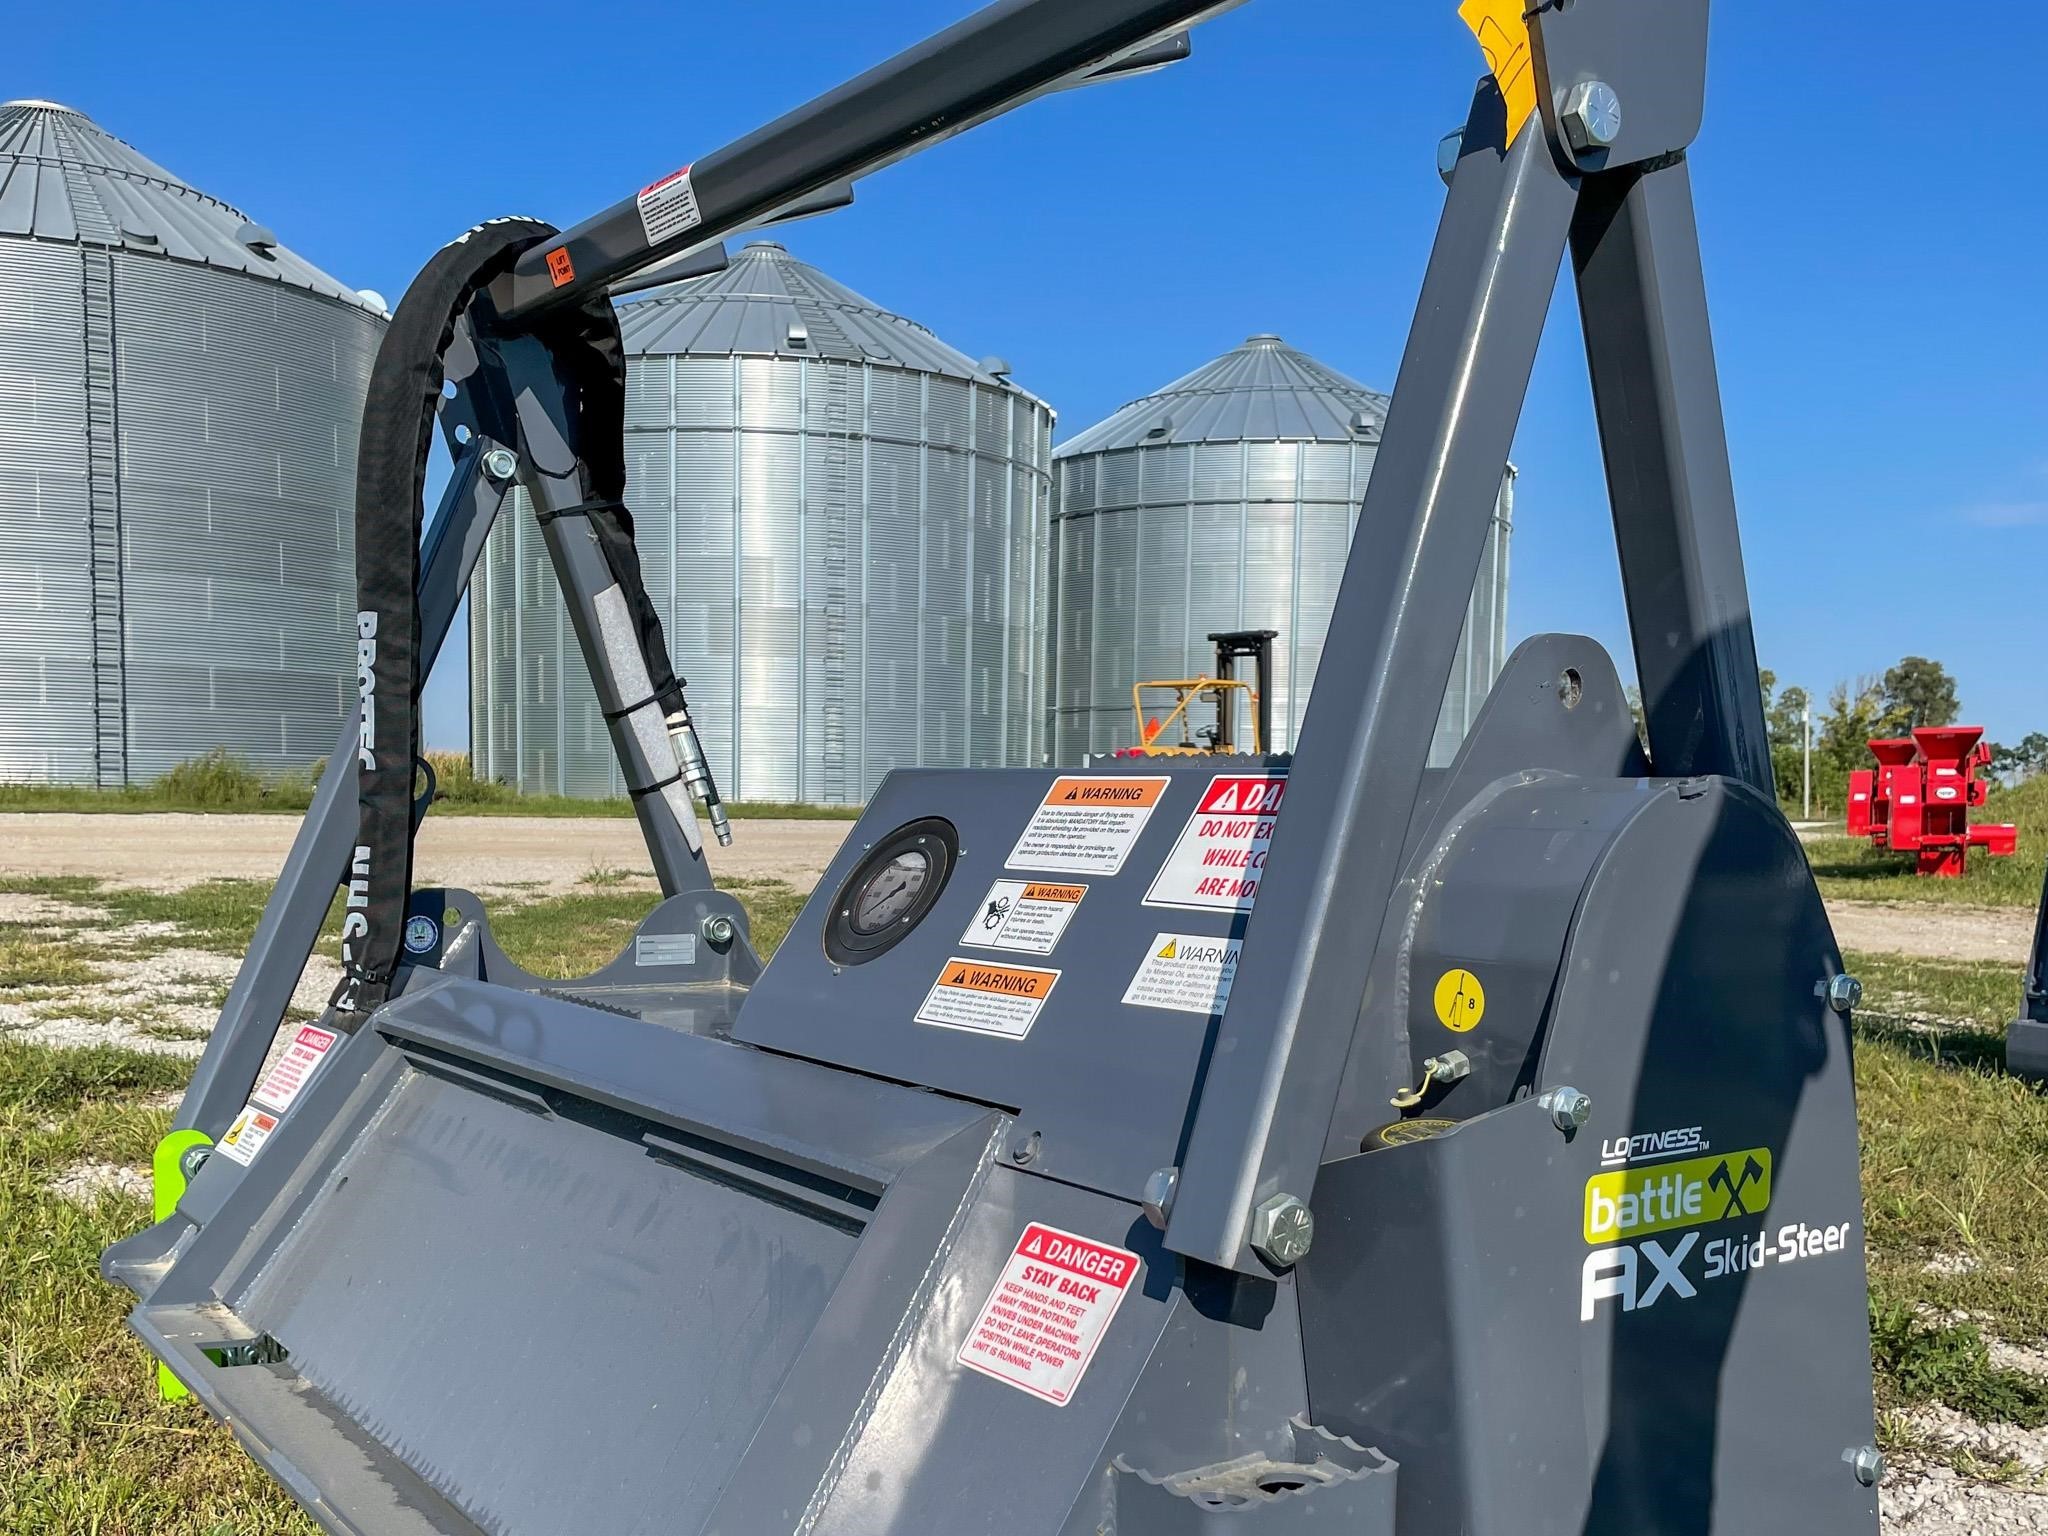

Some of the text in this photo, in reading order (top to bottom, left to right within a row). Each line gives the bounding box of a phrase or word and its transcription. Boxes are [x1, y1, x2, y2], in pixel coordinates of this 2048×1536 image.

[1081, 787, 1144, 800] WARNING
[1241, 784, 1282, 811] DA
[1198, 820, 1275, 839] DO NOT EX
[1202, 849, 1266, 868] WHILE C
[1037, 888, 1081, 900] WARNING
[1195, 878, 1228, 896] ARE
[1152, 959, 1163, 967] This
[1163, 961, 1186, 969] product
[1179, 945, 1239, 965] WARNIN
[969, 971, 1038, 993] WARNING
[1153, 968, 1175, 976] Mineral
[1187, 972, 1205, 980] which
[1158, 977, 1175, 985] State
[1175, 979, 1183, 987] of
[1182, 980, 1212, 990] California
[1177, 988, 1188, 996] For
[1188, 990, 1205, 998] more
[1468, 998, 1475, 1010] 8
[304, 1031, 332, 1049] DANGER
[1601, 1126, 1703, 1160] LOFTNESS
[1591, 1173, 1703, 1234] battle
[1045, 1239, 1126, 1281] DANGER
[1580, 1222, 1850, 1322] AX Skid-Steer
[1021, 1265, 1101, 1304] STAY BACK
[1003, 1282, 1087, 1317] KEEP HANDS AND FEET
[997, 1293, 1077, 1329] AWAY FROM ROTATING
[991, 1305, 1080, 1345] KNIVES UNDER MACHINE
[978, 1328, 1064, 1368] POSITION WHILE POWER
[984, 1316, 1082, 1360] DO NOT LEAVE OPERATORS
[972, 1340, 1032, 1371] UNIT IS RUNNING.
